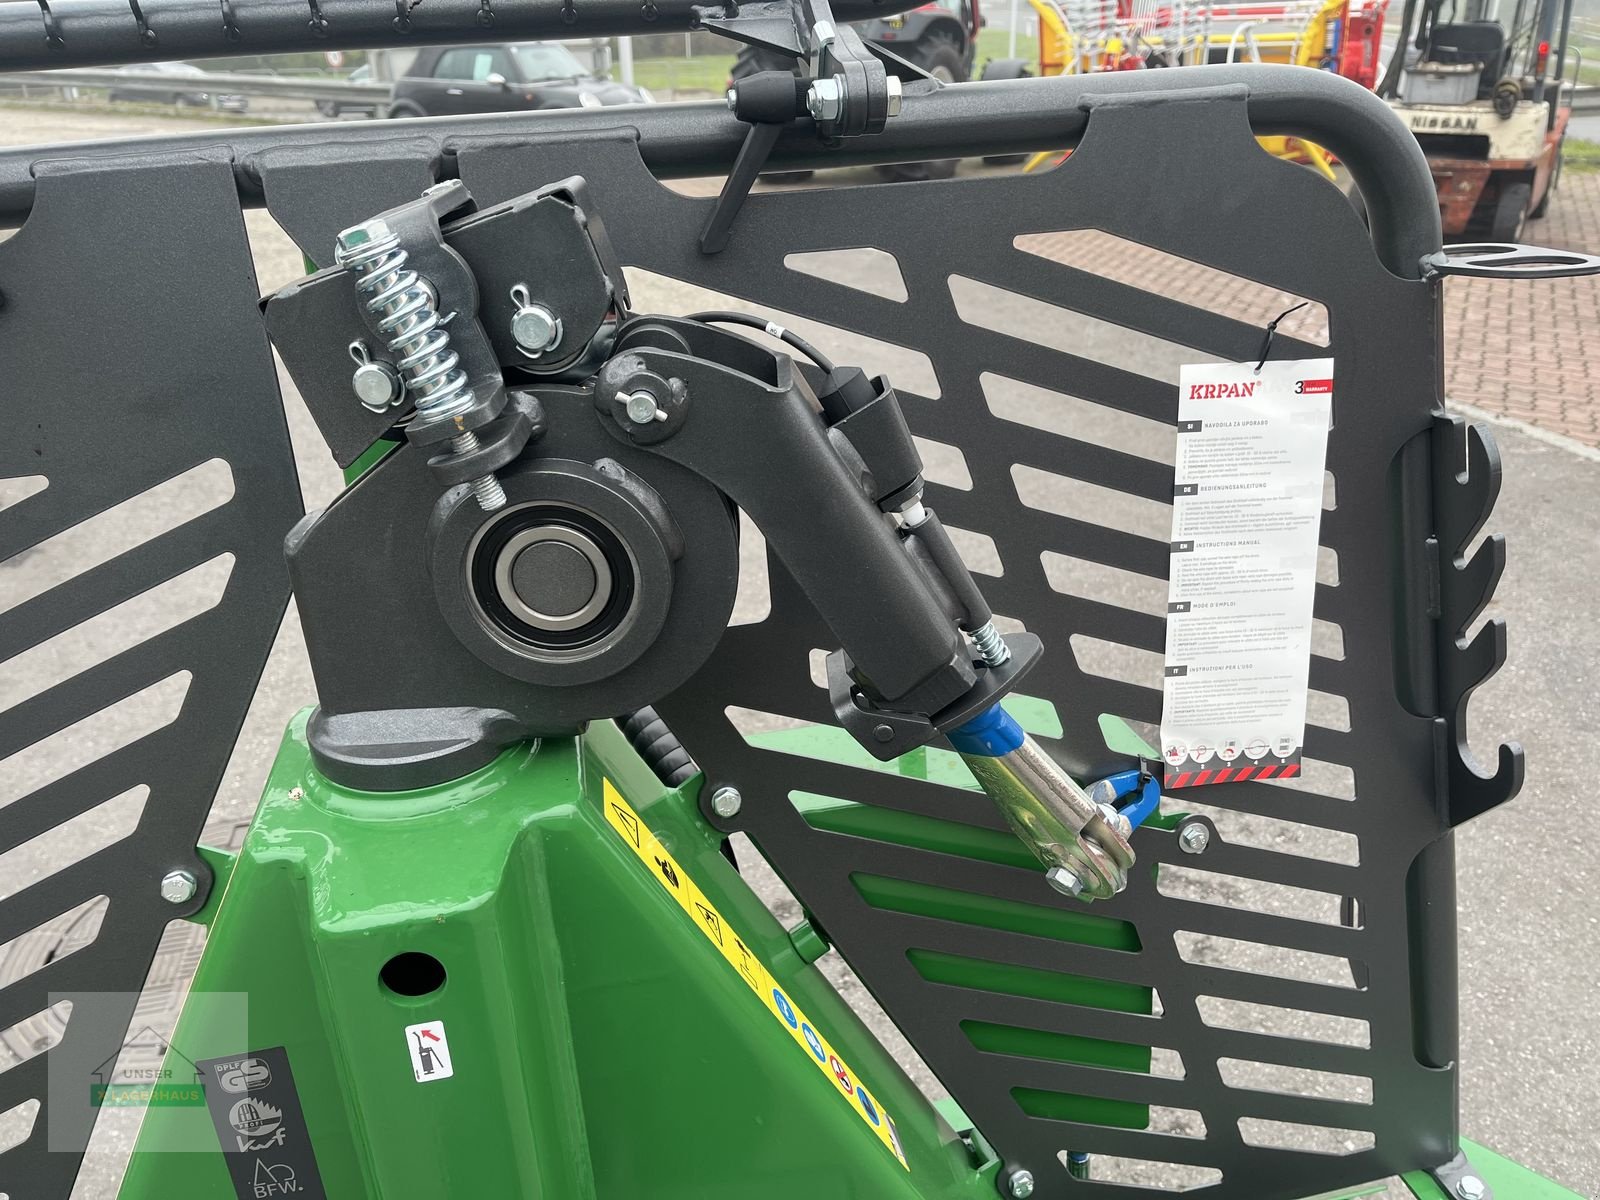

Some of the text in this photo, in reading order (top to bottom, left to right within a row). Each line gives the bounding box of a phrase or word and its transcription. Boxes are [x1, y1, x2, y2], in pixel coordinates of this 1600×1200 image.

[1410, 115, 1478, 130] NISSAN
[1294, 380, 1304, 394] 3
[1200, 483, 1267, 492] BEDIENUNGSANLEITUNG
[216, 1062, 240, 1072] DPLF
[239, 1120, 264, 1129] PROFI
